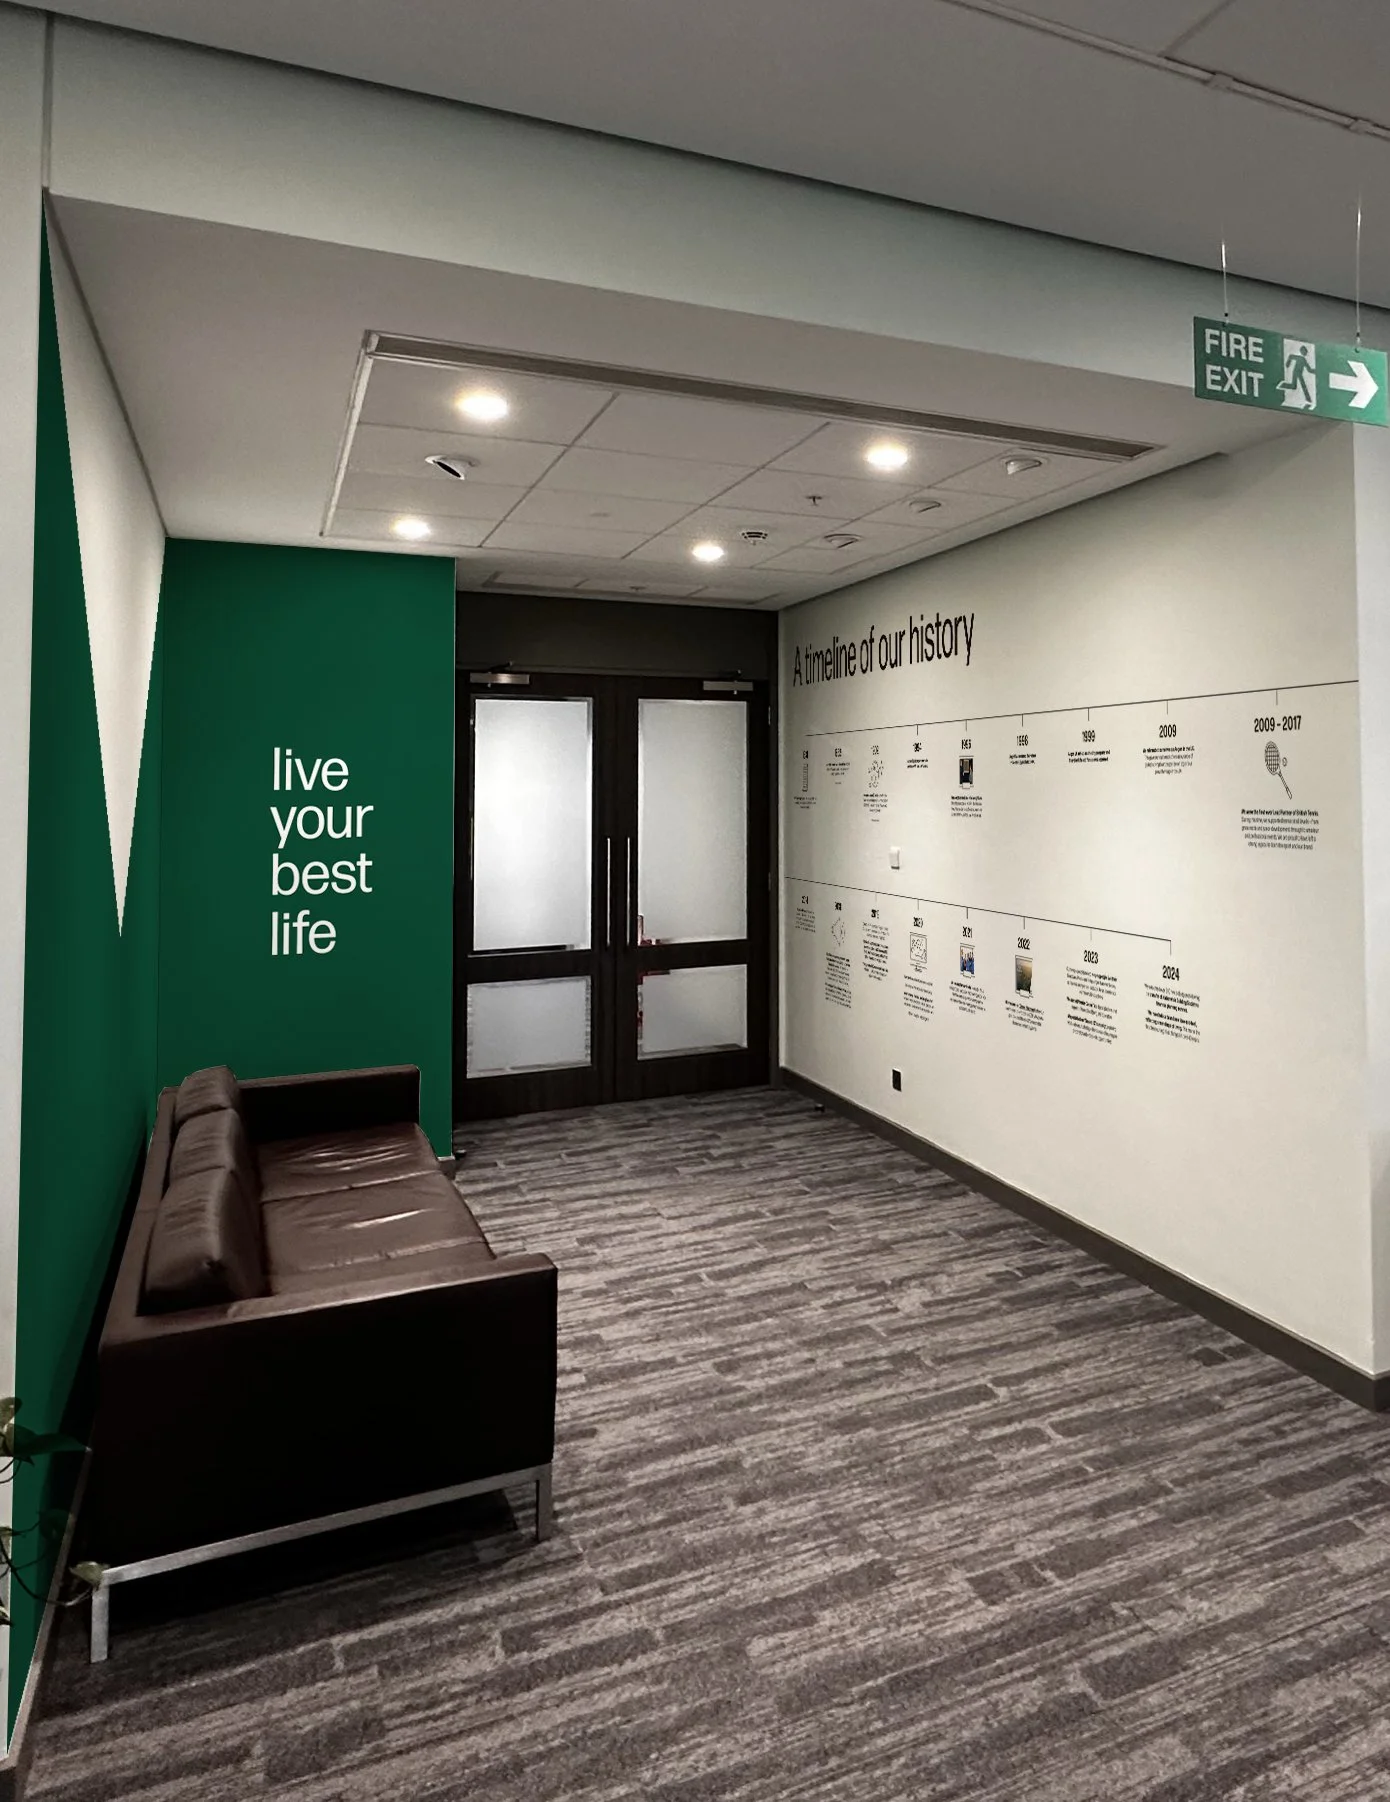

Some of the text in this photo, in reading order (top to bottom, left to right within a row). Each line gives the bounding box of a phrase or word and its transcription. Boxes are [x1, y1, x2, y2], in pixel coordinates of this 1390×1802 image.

[1204, 328, 1264, 363] FIRE
[1205, 364, 1264, 398] EXIT
[793, 612, 975, 687] A timeline of our history
[1082, 730, 1096, 743] 1999
[1159, 724, 1177, 738] 2009
[1254, 717, 1275, 732] 2009
[1282, 715, 1302, 731] 2017
[273, 747, 349, 791] live
[270, 805, 374, 849] your
[272, 853, 373, 896] best
[271, 909, 337, 956] life
[1017, 936, 1031, 950] 2022
[1083, 950, 1099, 964] 2023
[1162, 965, 1180, 981] 2024
